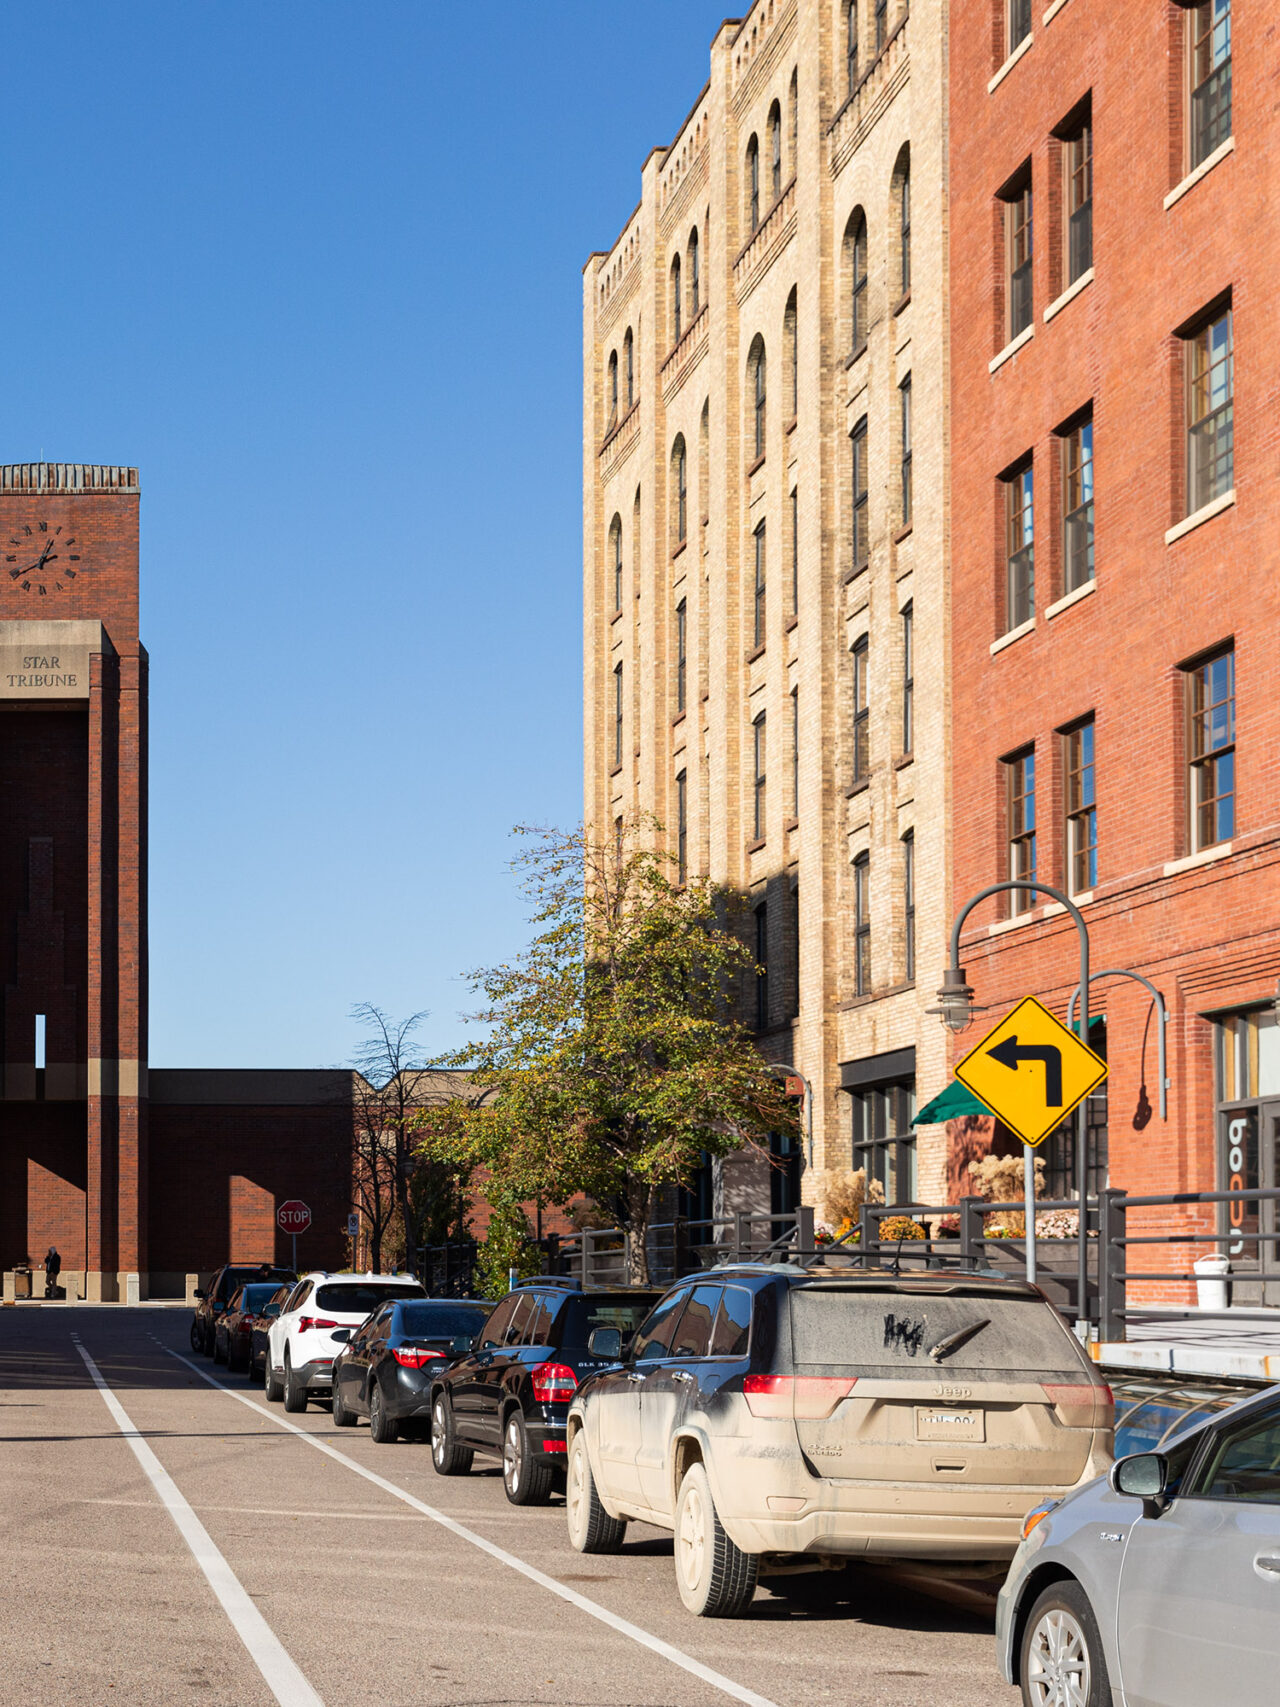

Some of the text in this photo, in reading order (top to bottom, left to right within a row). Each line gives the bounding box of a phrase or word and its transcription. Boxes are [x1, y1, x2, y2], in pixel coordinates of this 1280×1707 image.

[23, 656, 61, 669] STAR
[6, 674, 78, 687] TRIBUNE
[279, 1210, 309, 1224] STOP
[932, 1384, 972, 1399] Jeep
